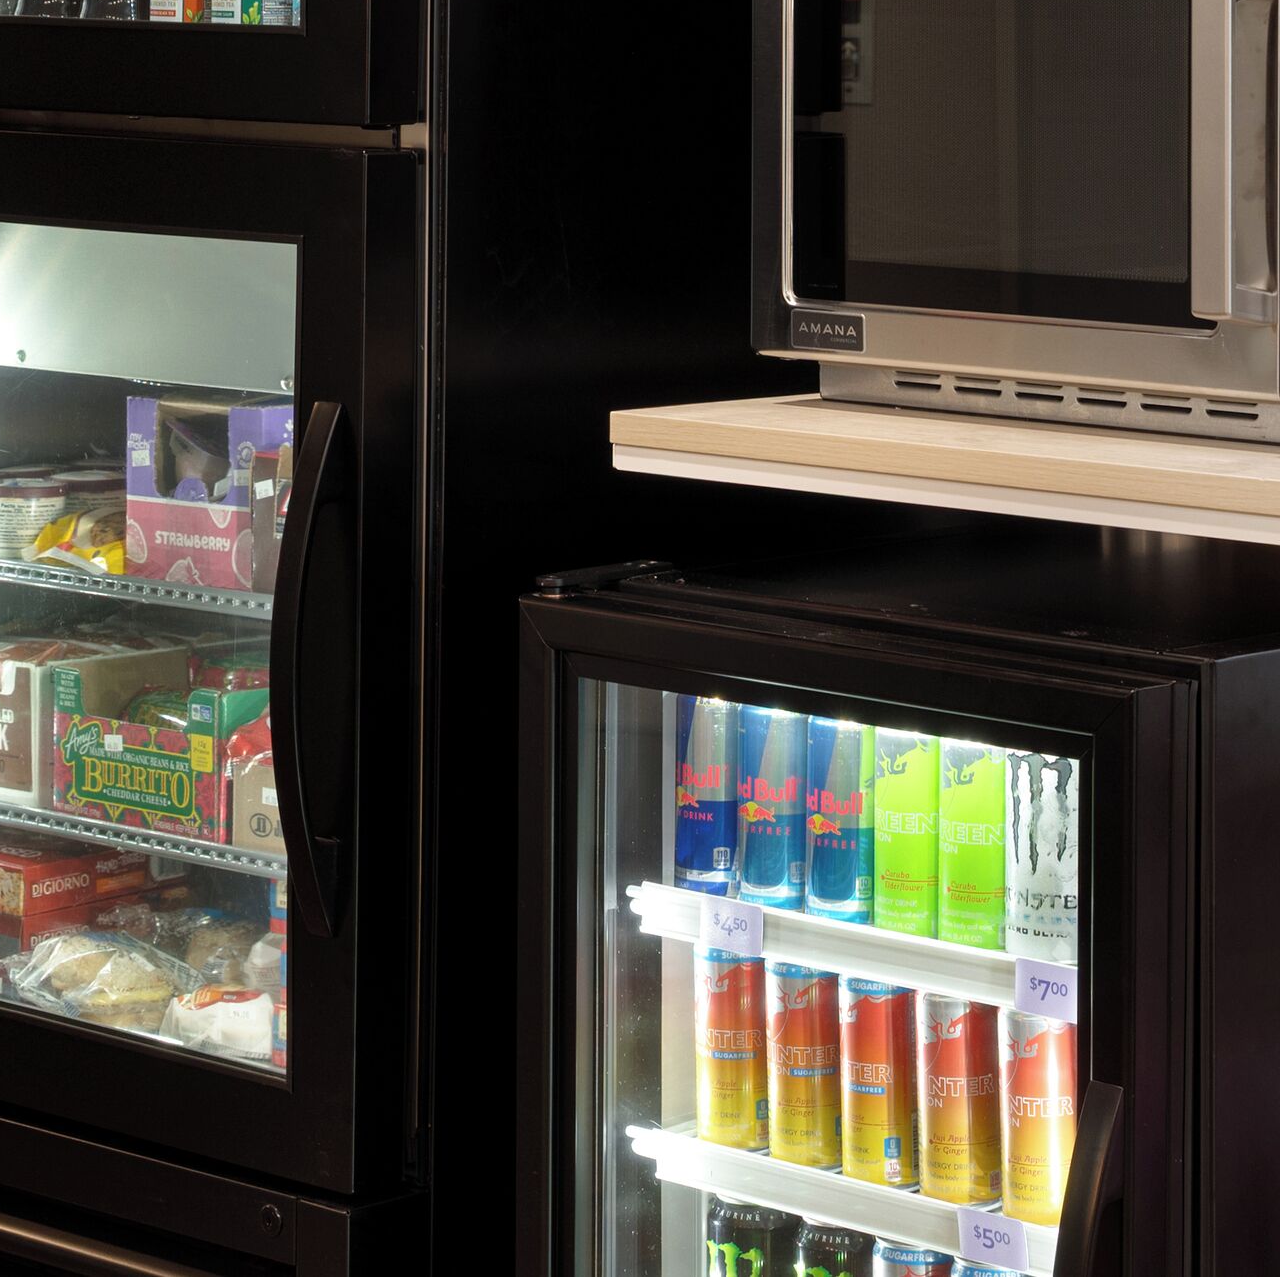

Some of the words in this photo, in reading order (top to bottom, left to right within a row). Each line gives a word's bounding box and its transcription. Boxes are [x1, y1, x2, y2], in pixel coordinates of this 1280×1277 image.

[799, 322, 856, 337] AMANA
[66, 724, 99, 757] Amy's
[82, 756, 190, 809] BURRITO
[821, 791, 863, 815] Bull
[714, 1051, 756, 1059] SUGARFREE
[715, 1207, 761, 1221] TAURINE
